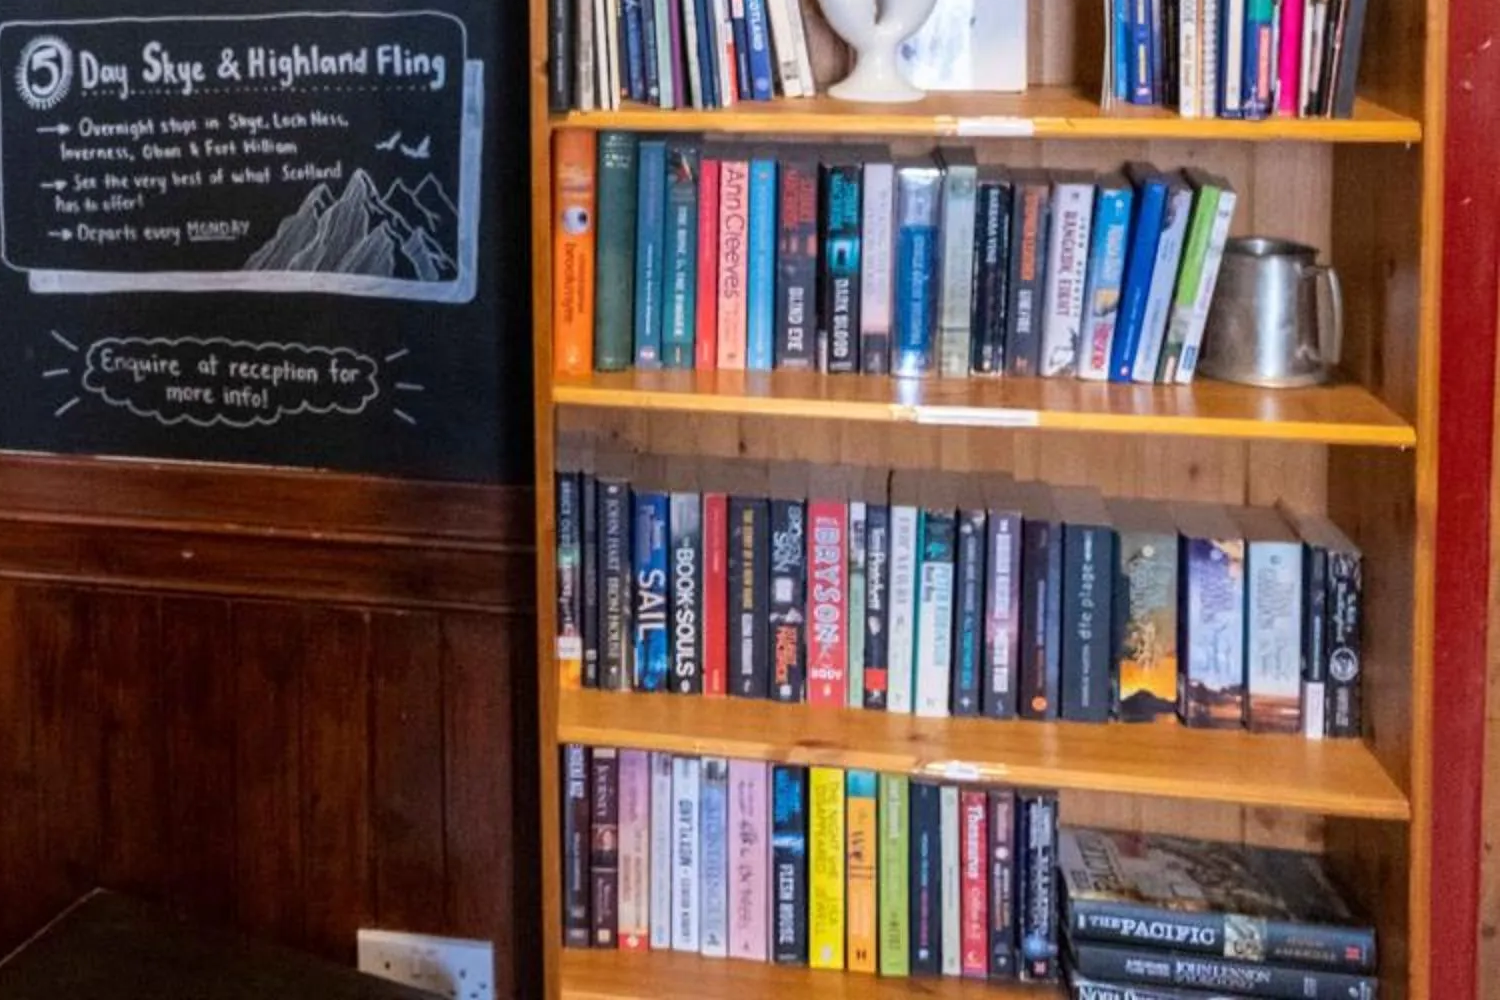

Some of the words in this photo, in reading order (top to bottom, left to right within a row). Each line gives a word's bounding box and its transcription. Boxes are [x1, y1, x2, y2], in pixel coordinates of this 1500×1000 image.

[30, 43, 62, 95] 5
[80, 49, 129, 99] Day
[142, 41, 205, 97] Skye
[218, 48, 241, 80] &
[247, 44, 369, 86] Highland
[376, 45, 445, 90] Fling
[79, 116, 155, 141] Overnight
[160, 118, 197, 136] stops
[205, 118, 219, 129] in
[273, 111, 307, 128] Loch
[143, 144, 181, 160] Oban
[205, 140, 236, 156] Fort
[244, 139, 298, 155] William
[73, 173, 97, 190] See
[104, 172, 129, 188] the
[134, 176, 168, 194] very
[172, 168, 202, 185] best
[209, 168, 225, 184] of
[232, 166, 271, 184] what
[282, 160, 343, 180] Scotland
[727, 168, 744, 211] Ann
[55, 195, 80, 212] has
[84, 196, 98, 212] to
[77, 223, 137, 244] Departs
[143, 226, 181, 246] every
[187, 219, 249, 236] MONDAY
[1059, 211, 1079, 275] BANGKOK
[724, 213, 744, 299] Cleeves
[788, 286, 803, 324] BLIND
[834, 278, 849, 313] DARK
[1056, 280, 1075, 317] EIGHT
[787, 327, 802, 351] EYE
[833, 315, 849, 357] BLOOD
[100, 352, 180, 382] Enquire
[198, 357, 219, 378] at
[229, 357, 318, 385] reception
[329, 362, 360, 383] for
[166, 383, 212, 403] more
[224, 386, 269, 409] info!
[607, 500, 618, 536] JOHN
[607, 538, 619, 572] HART
[607, 577, 618, 612] IRON
[676, 549, 694, 605] BOOK
[813, 526, 842, 643] BRYSON
[868, 551, 885, 610] Pratchett
[1078, 563, 1096, 608] plage
[638, 569, 665, 642] SAIL
[608, 615, 619, 659] HOUSE
[676, 609, 695, 676] SOULS
[1078, 612, 1094, 640] die
[966, 805, 985, 880] Thesaurus
[779, 863, 794, 900] FLESH
[779, 903, 794, 945] HOUSE
[1090, 917, 1121, 931] THE
[1120, 918, 1216, 946] PACIFIC
